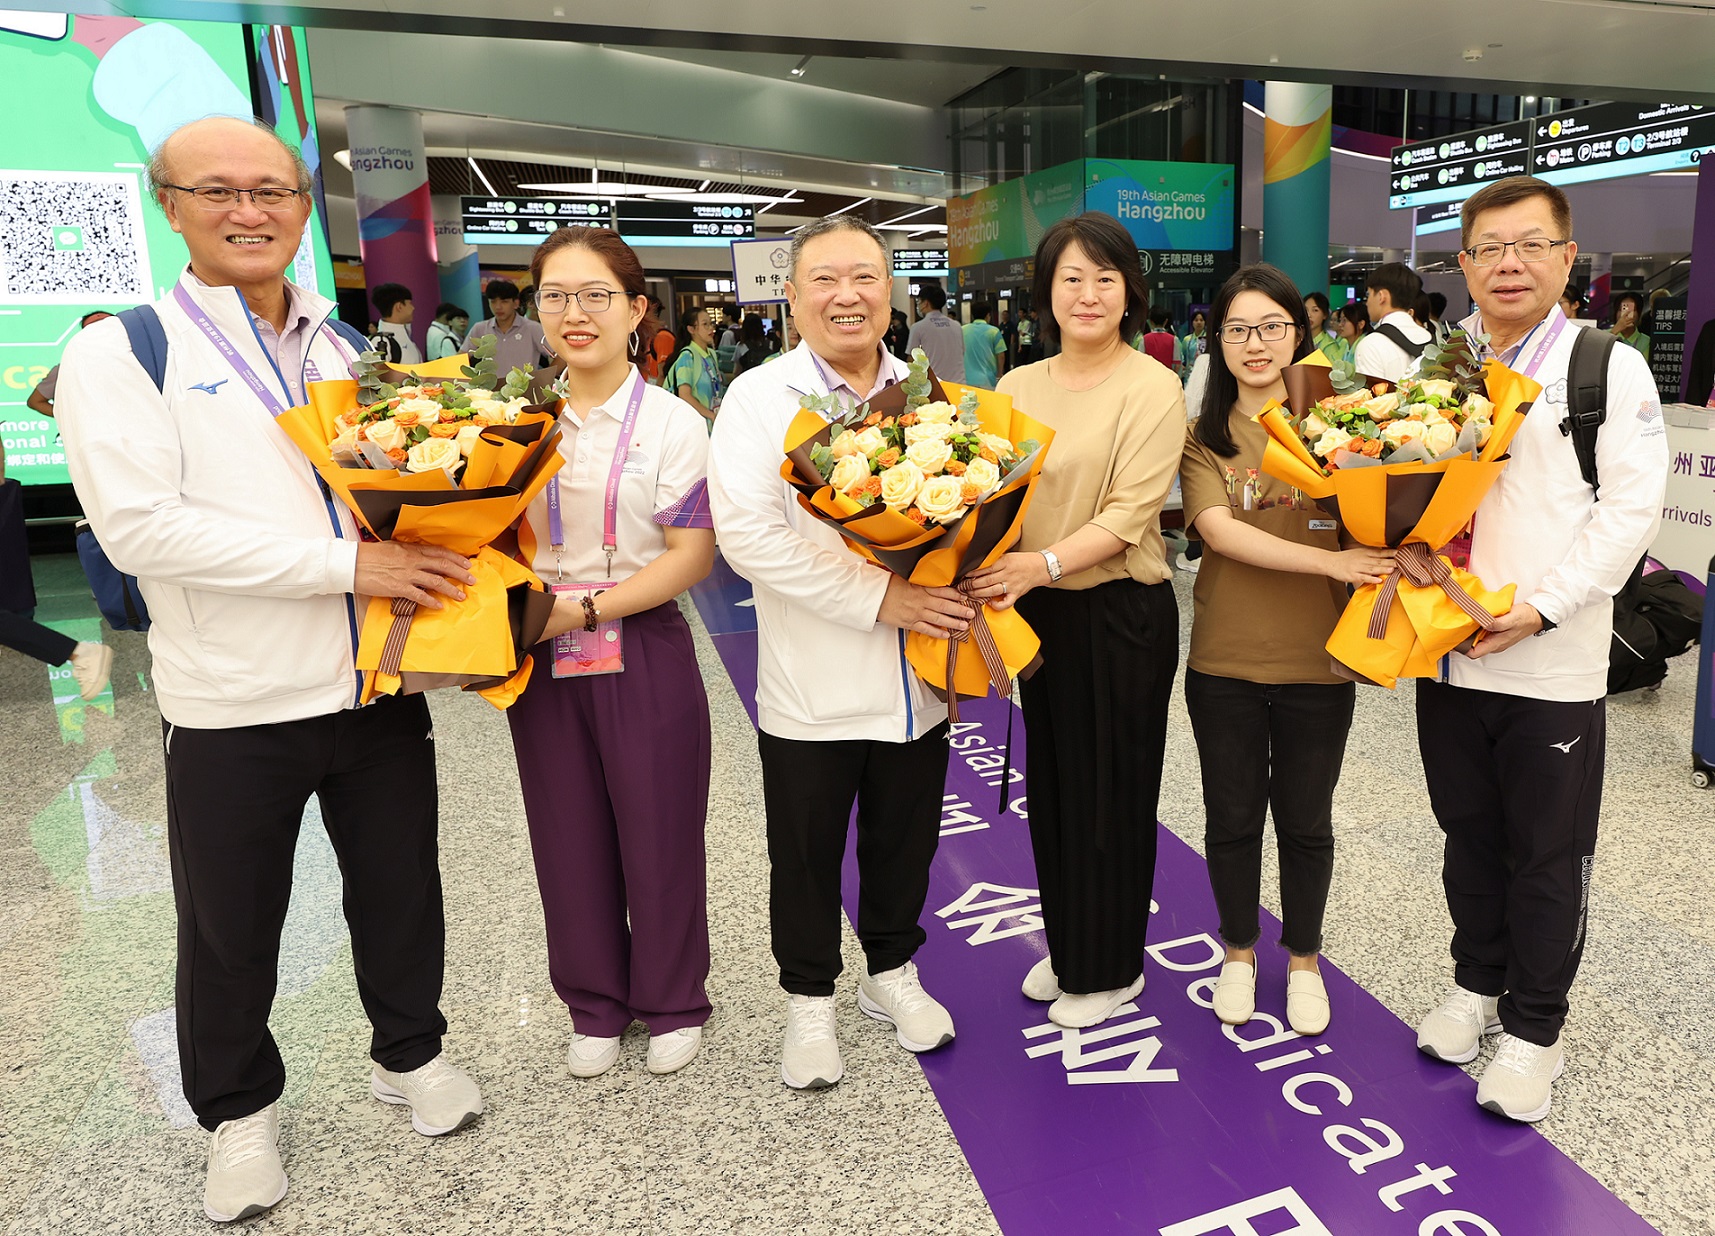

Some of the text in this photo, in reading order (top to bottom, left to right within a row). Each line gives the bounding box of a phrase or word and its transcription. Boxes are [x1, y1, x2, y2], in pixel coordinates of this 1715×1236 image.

[1638, 110, 1666, 120] Domestic
[1666, 104, 1690, 115] Arrivals
[378, 146, 412, 157] Games
[1646, 140, 1670, 150] Terminal
[352, 156, 414, 172] angzhou
[1117, 190, 1206, 203] 19th Asian Games
[1118, 202, 1206, 222] Hangzhou
[950, 218, 999, 250] Hangzhou
[1160, 254, 1214, 266] 无障碍电梯
[755, 274, 789, 286] 中华
[772, 288, 786, 296] TP
[1655, 310, 1687, 320] 温馨提示
[1655, 322, 1672, 330] TIPS
[0, 420, 49, 432] more
[3, 435, 46, 449] onal
[6, 452, 68, 466] 绑定和使
[1662, 505, 1712, 526] rrivals
[949, 722, 1024, 786] Asian
